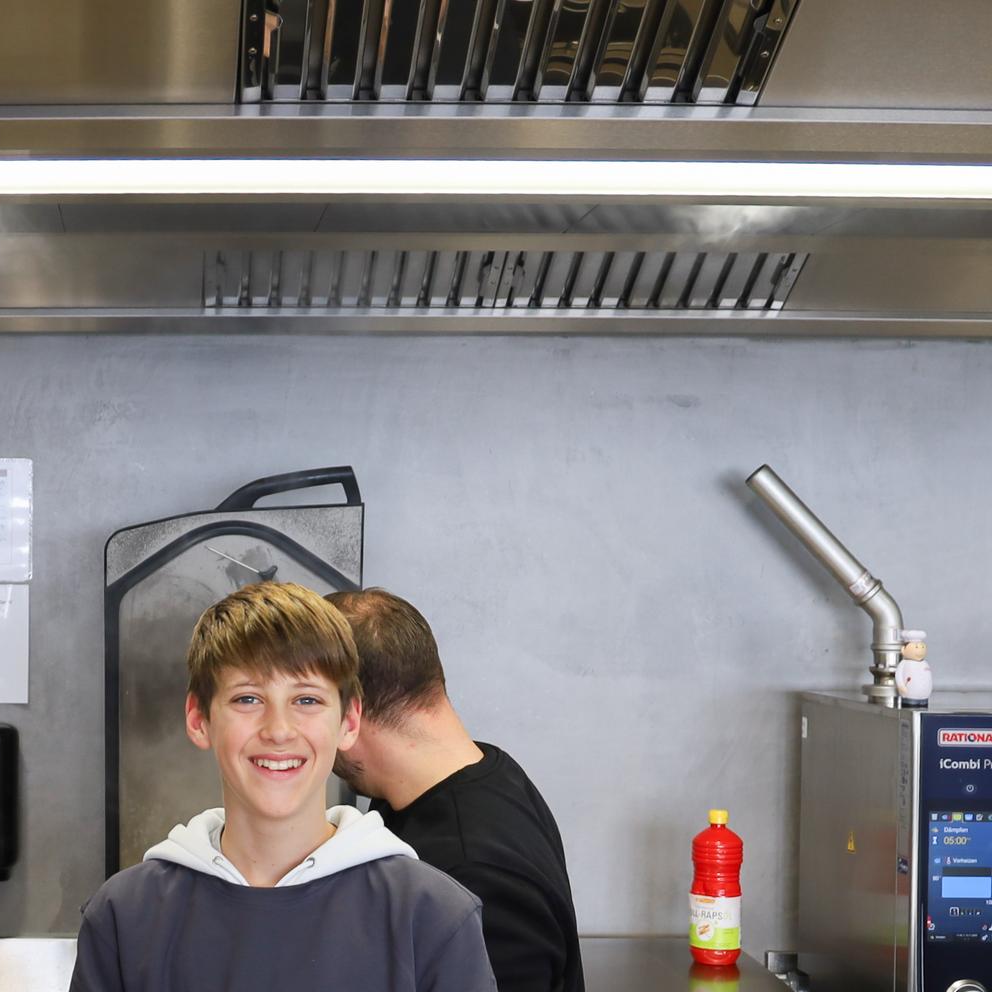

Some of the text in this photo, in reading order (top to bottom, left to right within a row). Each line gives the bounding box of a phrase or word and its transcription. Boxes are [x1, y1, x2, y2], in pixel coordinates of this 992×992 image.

[939, 758, 992, 770] iCombi P
[943, 836, 967, 845] 05:00
